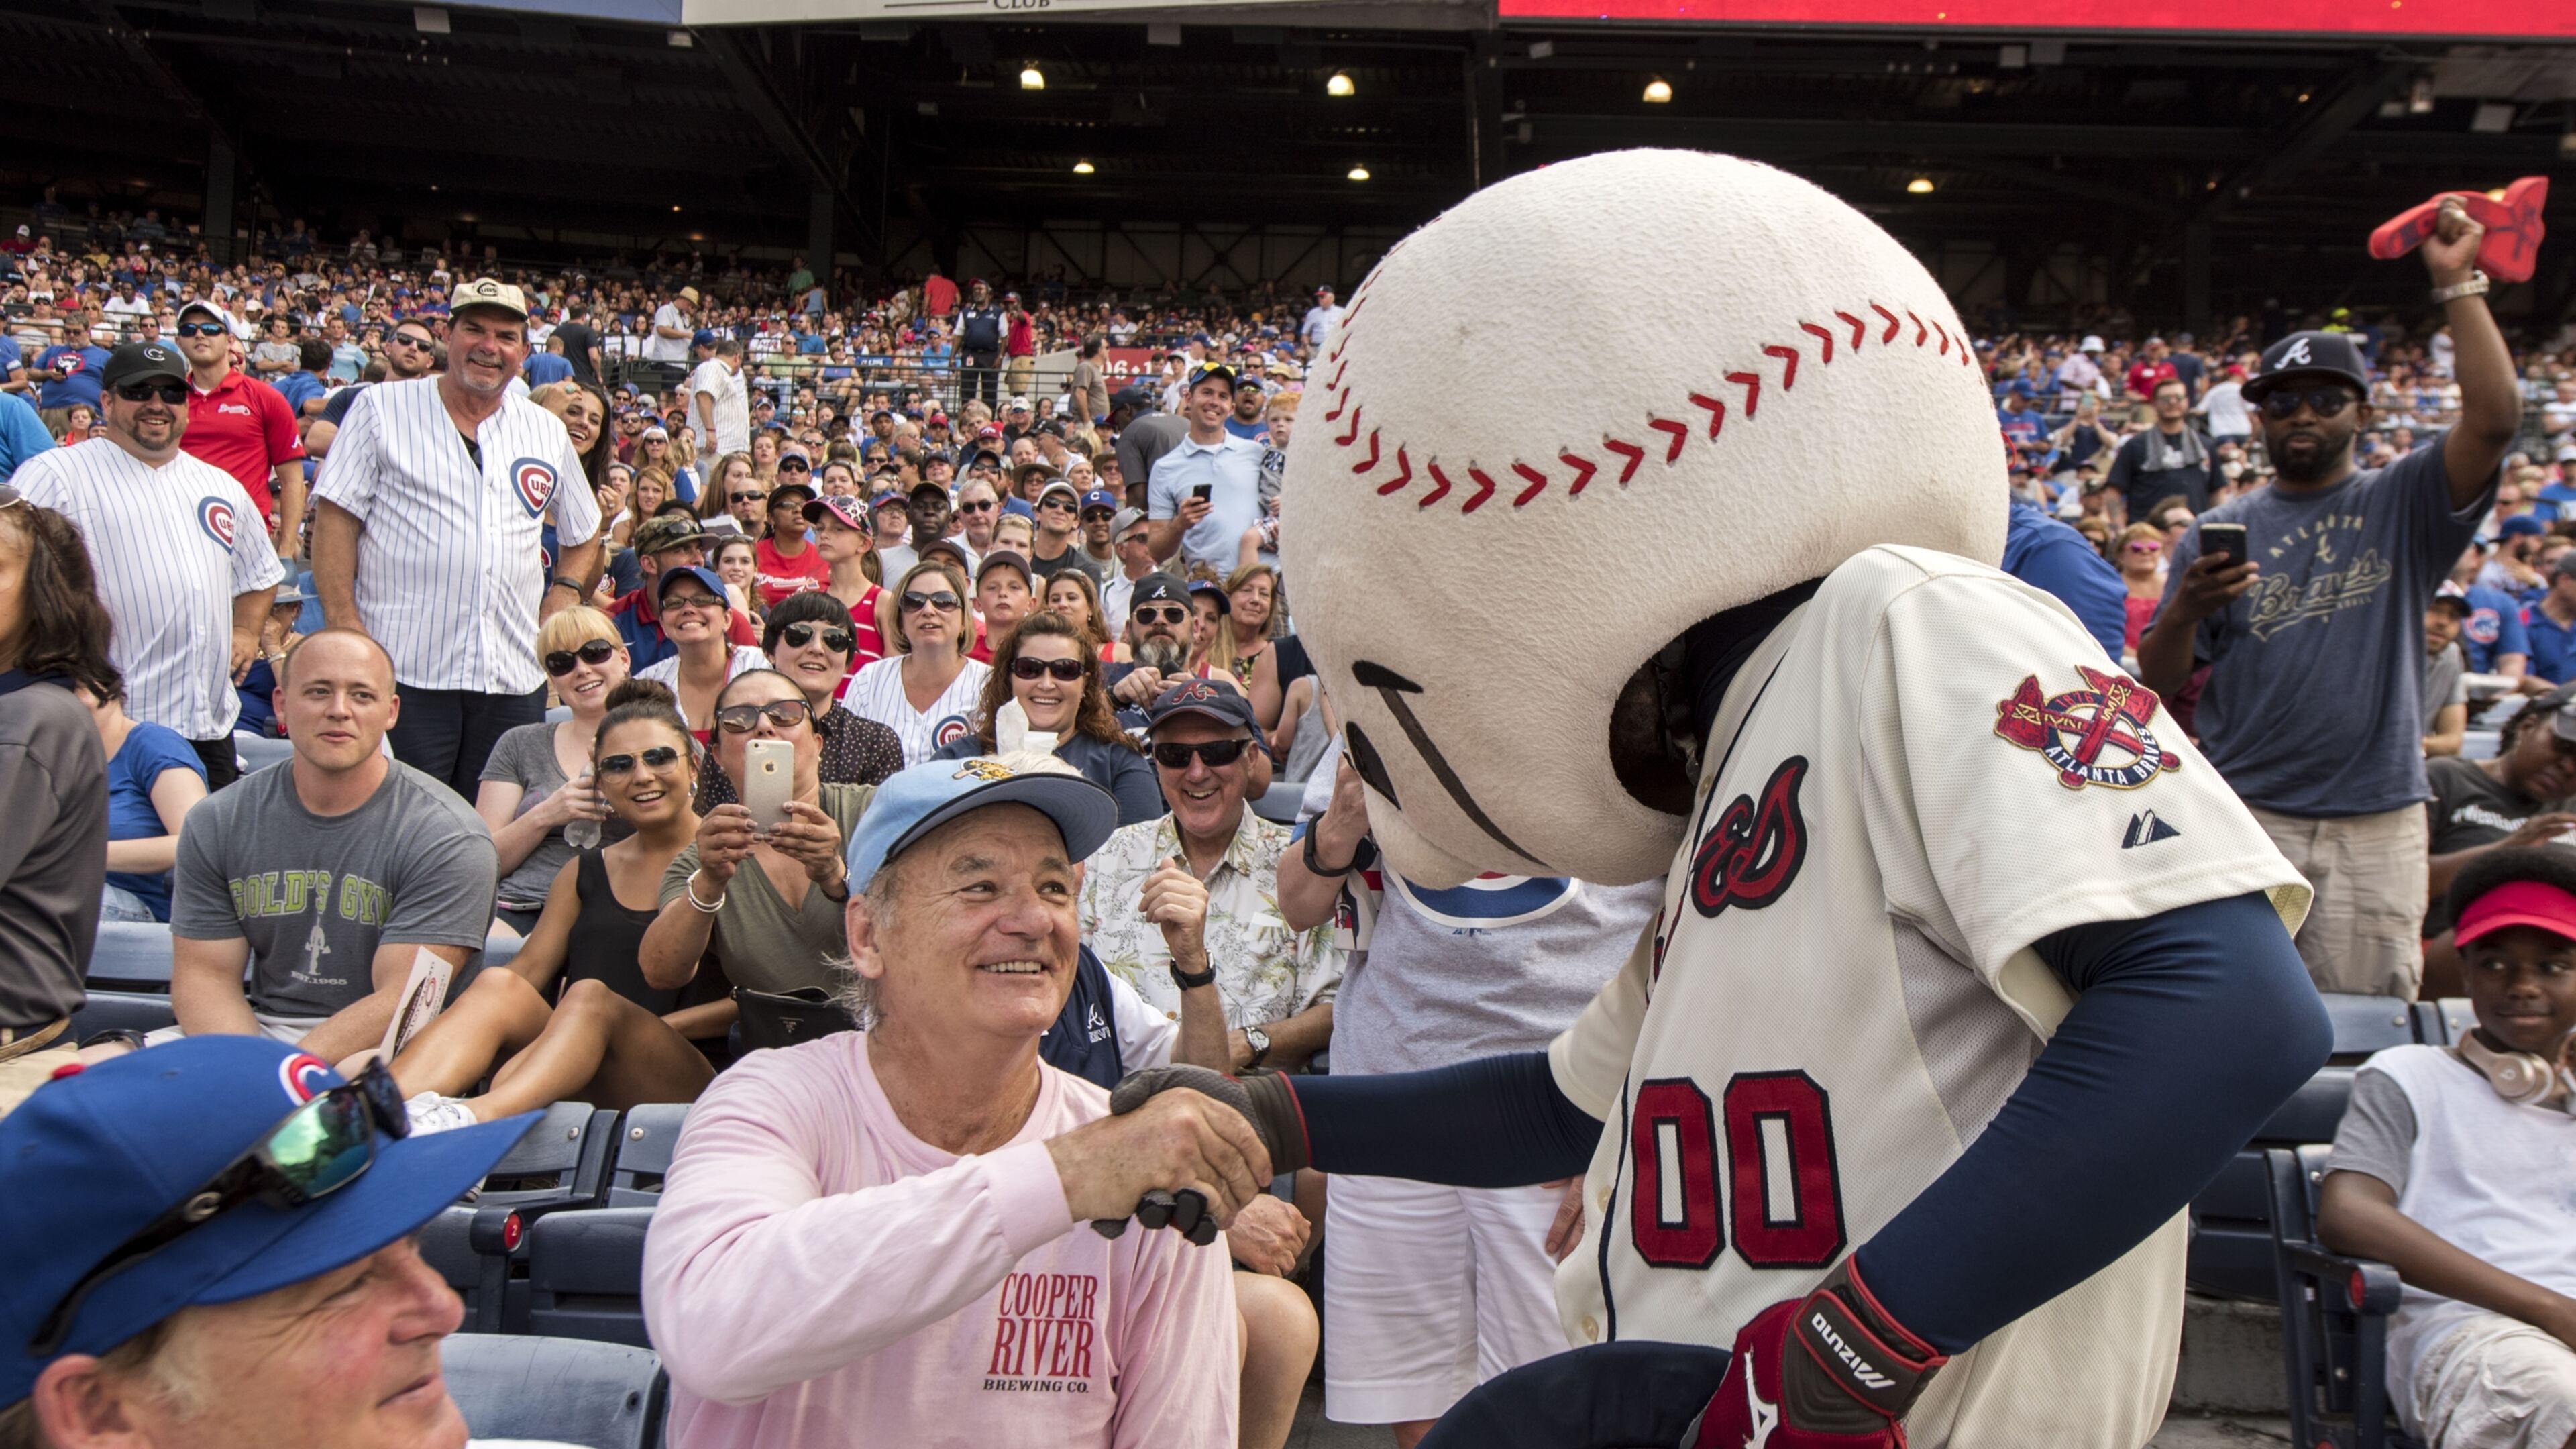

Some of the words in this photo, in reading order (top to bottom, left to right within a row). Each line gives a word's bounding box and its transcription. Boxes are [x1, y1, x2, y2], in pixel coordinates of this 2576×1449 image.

[2273, 337, 2312, 370] A
[1090, 491, 1100, 500] C
[1151, 585, 1167, 598] A
[2055, 693, 2094, 709] 1876
[2045, 745, 2129, 785] ATLANTA
[2132, 727, 2160, 780] BRAVES
[229, 870, 333, 920] GOLD'S
[1631, 1069, 1849, 1271] 00
[512, 1224, 518, 1237] 2
[1000, 1273, 1099, 1320] COOPER
[987, 1317, 1094, 1379] RIVER
[1811, 1312, 1897, 1389] MIZUNO
[983, 1379, 1063, 1393] BREWING
[1067, 1381, 1089, 1394] CO.
